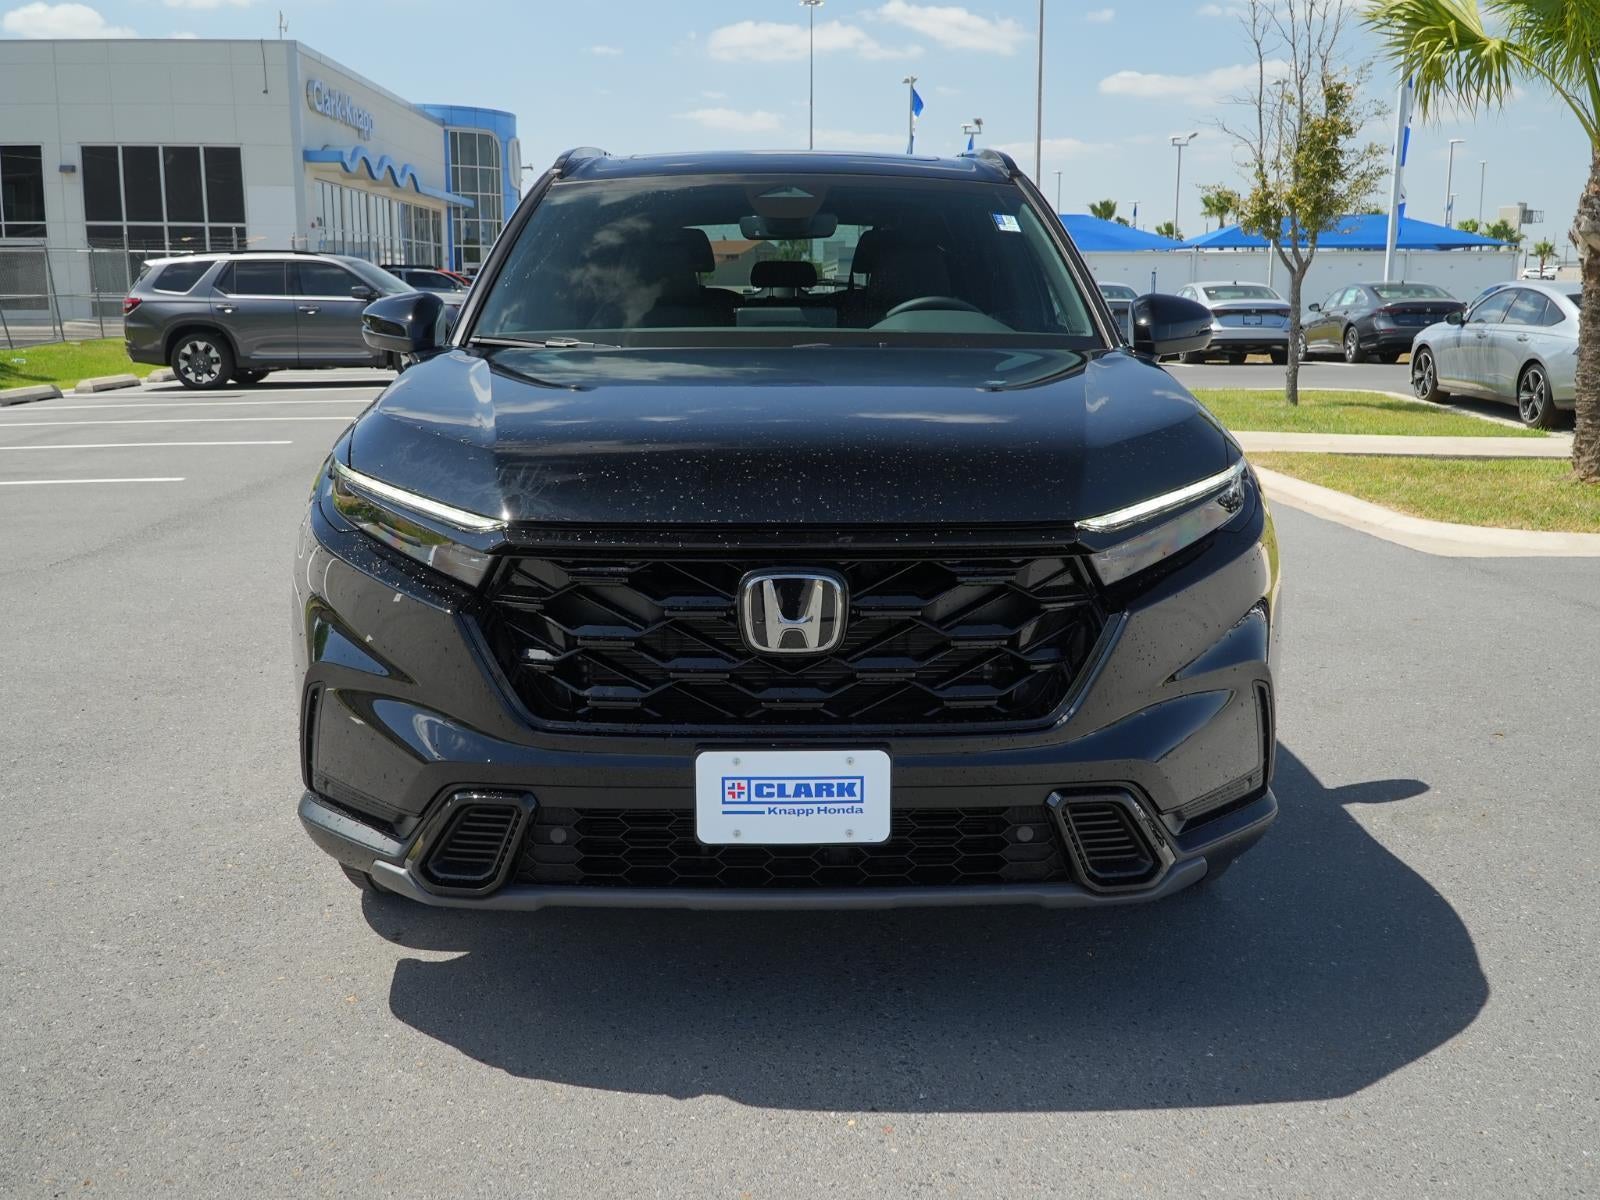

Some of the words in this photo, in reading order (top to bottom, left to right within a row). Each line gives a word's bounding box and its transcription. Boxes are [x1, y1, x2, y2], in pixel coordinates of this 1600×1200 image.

[754, 782, 857, 798] CLARK
[767, 806, 815, 817] Knapp
[817, 805, 864, 815] Honda
